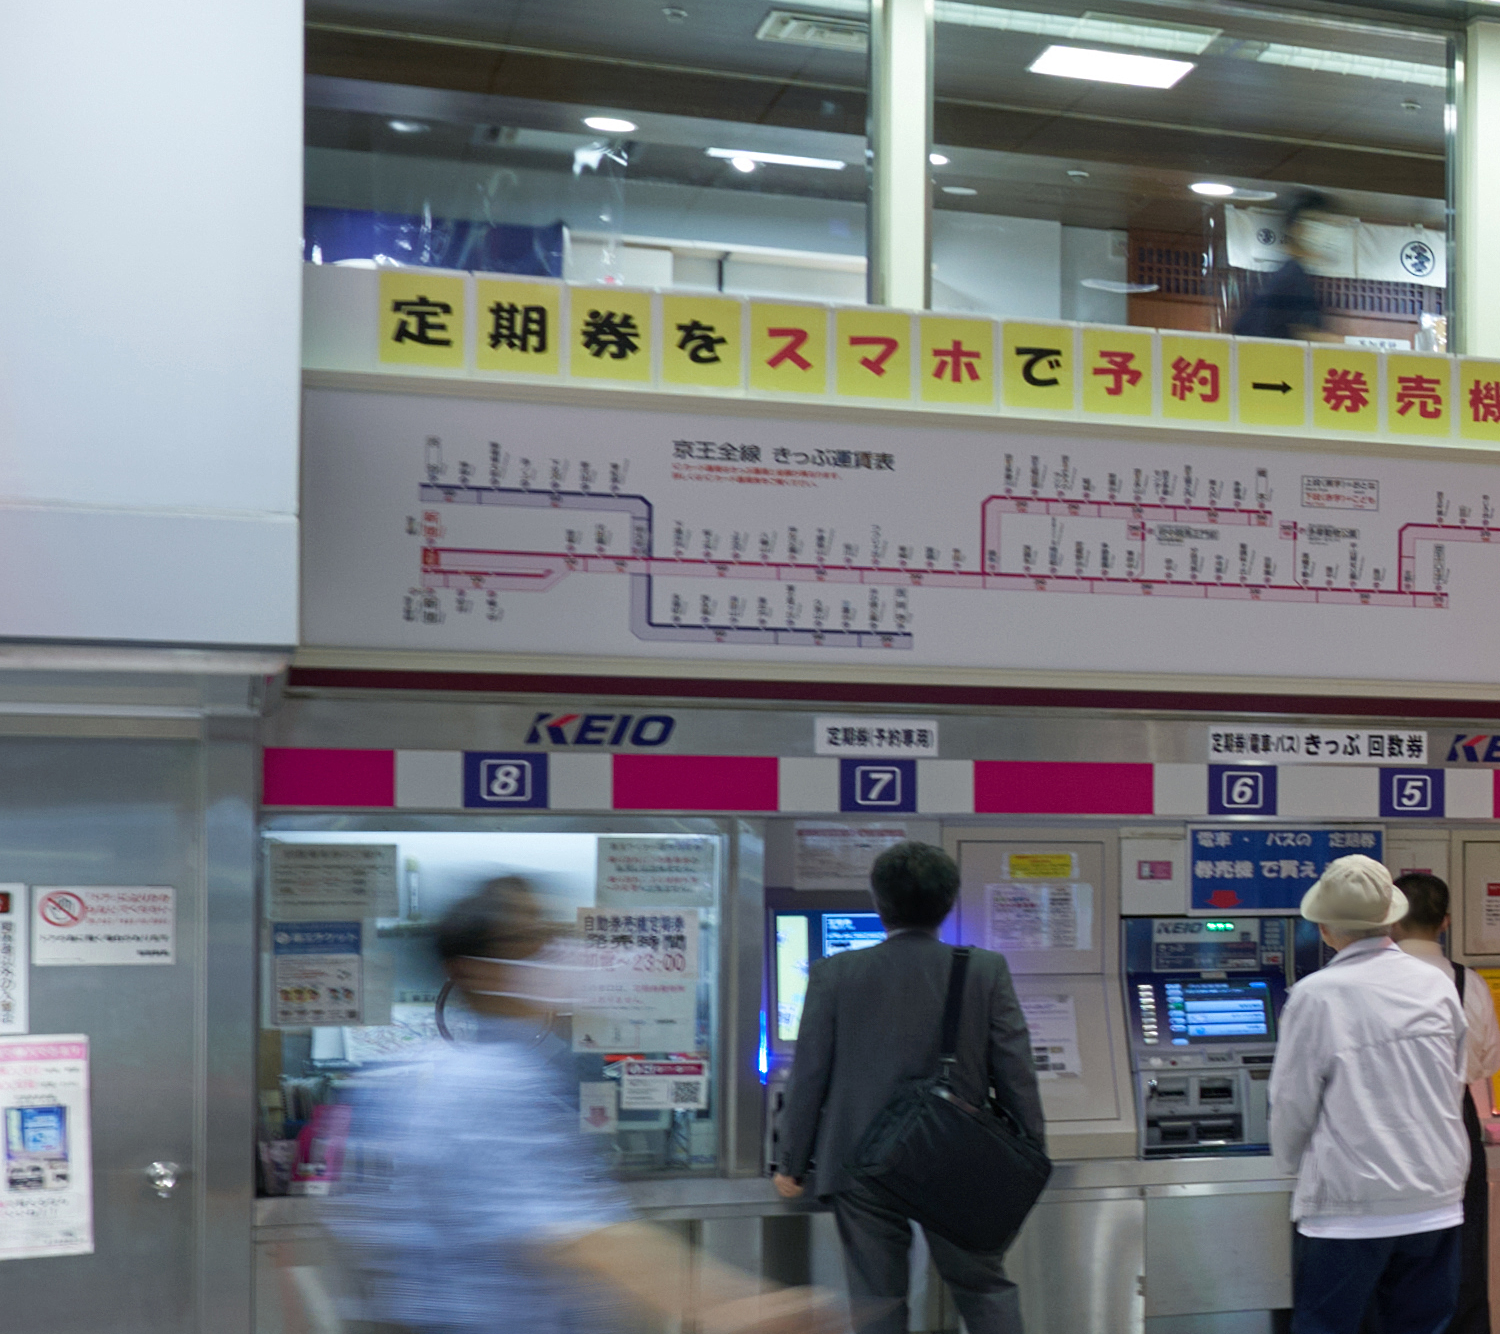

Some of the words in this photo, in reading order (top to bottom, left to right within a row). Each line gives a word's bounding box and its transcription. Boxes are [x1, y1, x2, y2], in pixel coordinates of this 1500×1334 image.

[391, 295, 1221, 404] 定期券をスマホで予約
[671, 439, 762, 464] 京王全線
[525, 712, 677, 747] KEIO
[1303, 734, 1362, 759] きっぷ
[1367, 734, 1425, 760] 回数券
[489, 764, 520, 797] 8
[866, 772, 891, 800] 7
[1231, 776, 1255, 806] 6
[1400, 778, 1424, 807] 5
[1259, 860, 1324, 879] で買え
